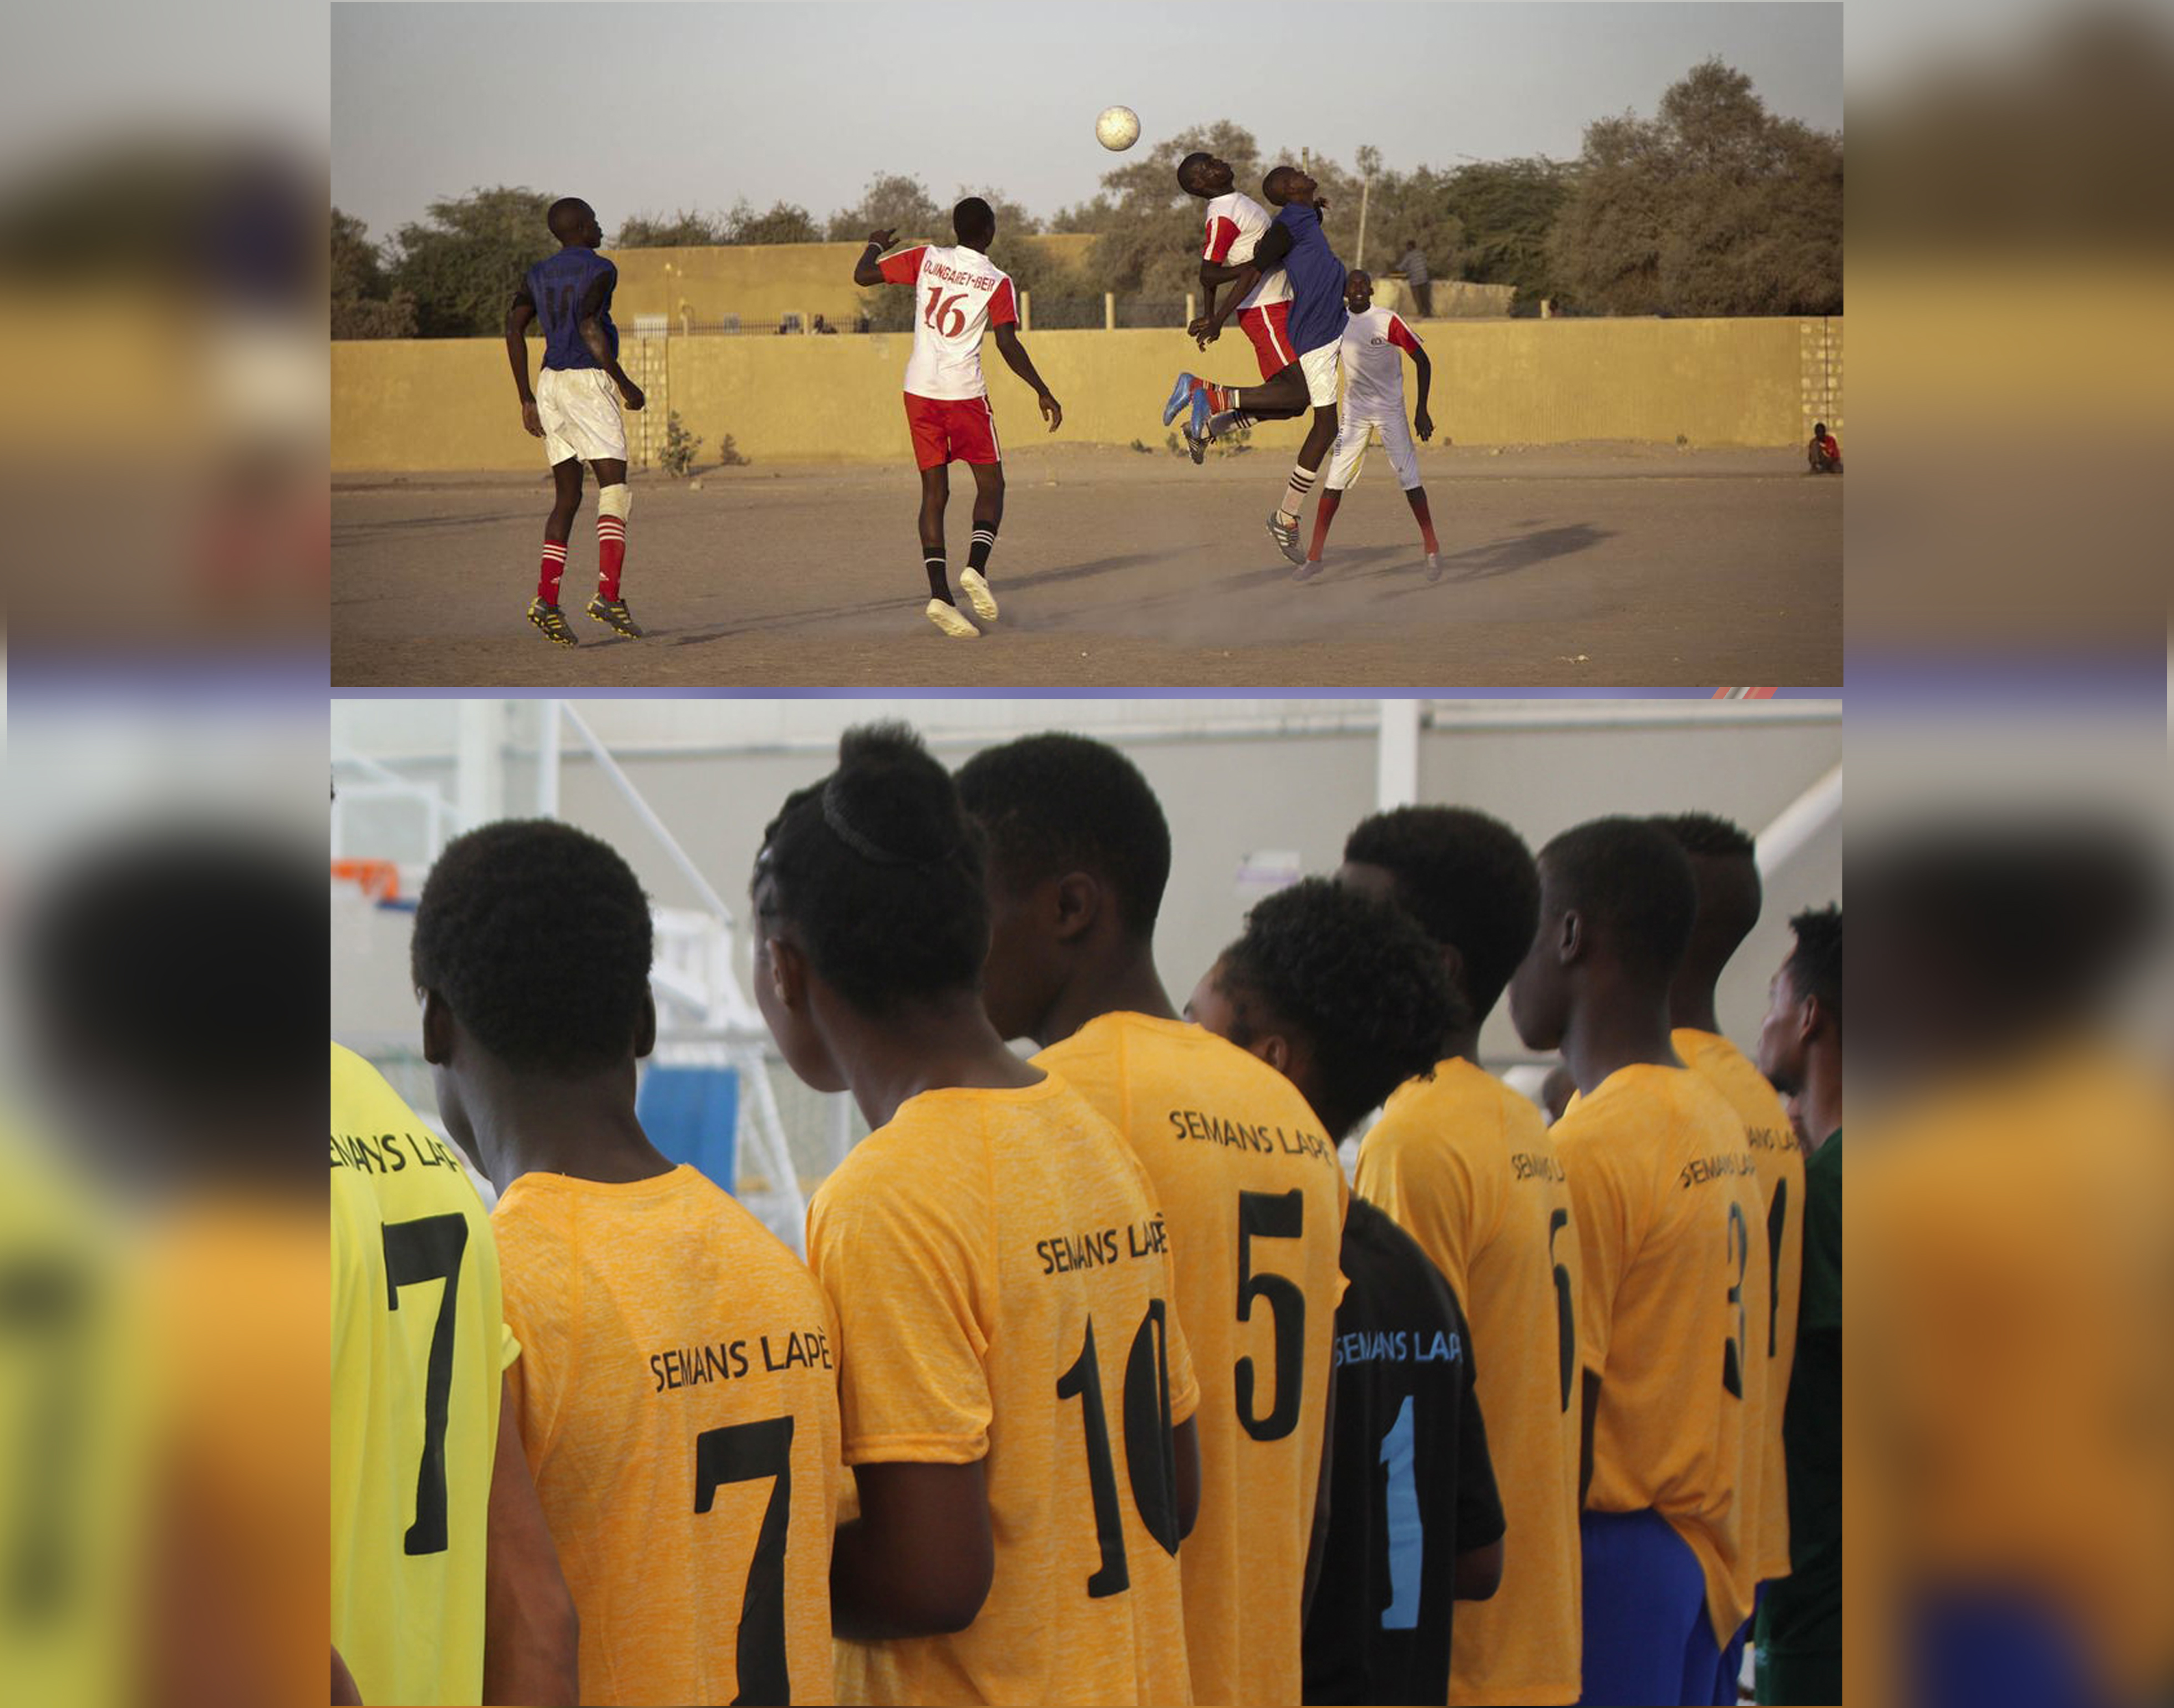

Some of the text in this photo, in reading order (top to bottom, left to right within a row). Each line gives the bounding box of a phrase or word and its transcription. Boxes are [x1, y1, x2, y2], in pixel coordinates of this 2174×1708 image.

[925, 286, 968, 338] 16
[1170, 1111, 1273, 1153] SEMANS
[1036, 1228, 1118, 1275] SEMANS
[1235, 1187, 1306, 1441] 5
[1335, 1331, 1407, 1368] SEMANS
[1723, 1201, 1748, 1400] 3
[382, 1212, 469, 1556] 7
[650, 1325, 833, 1393] SEMANS LAPÈ
[1056, 1298, 1179, 1598] 10
[694, 1415, 794, 1705] 7
[1379, 1395, 1423, 1630] 1
